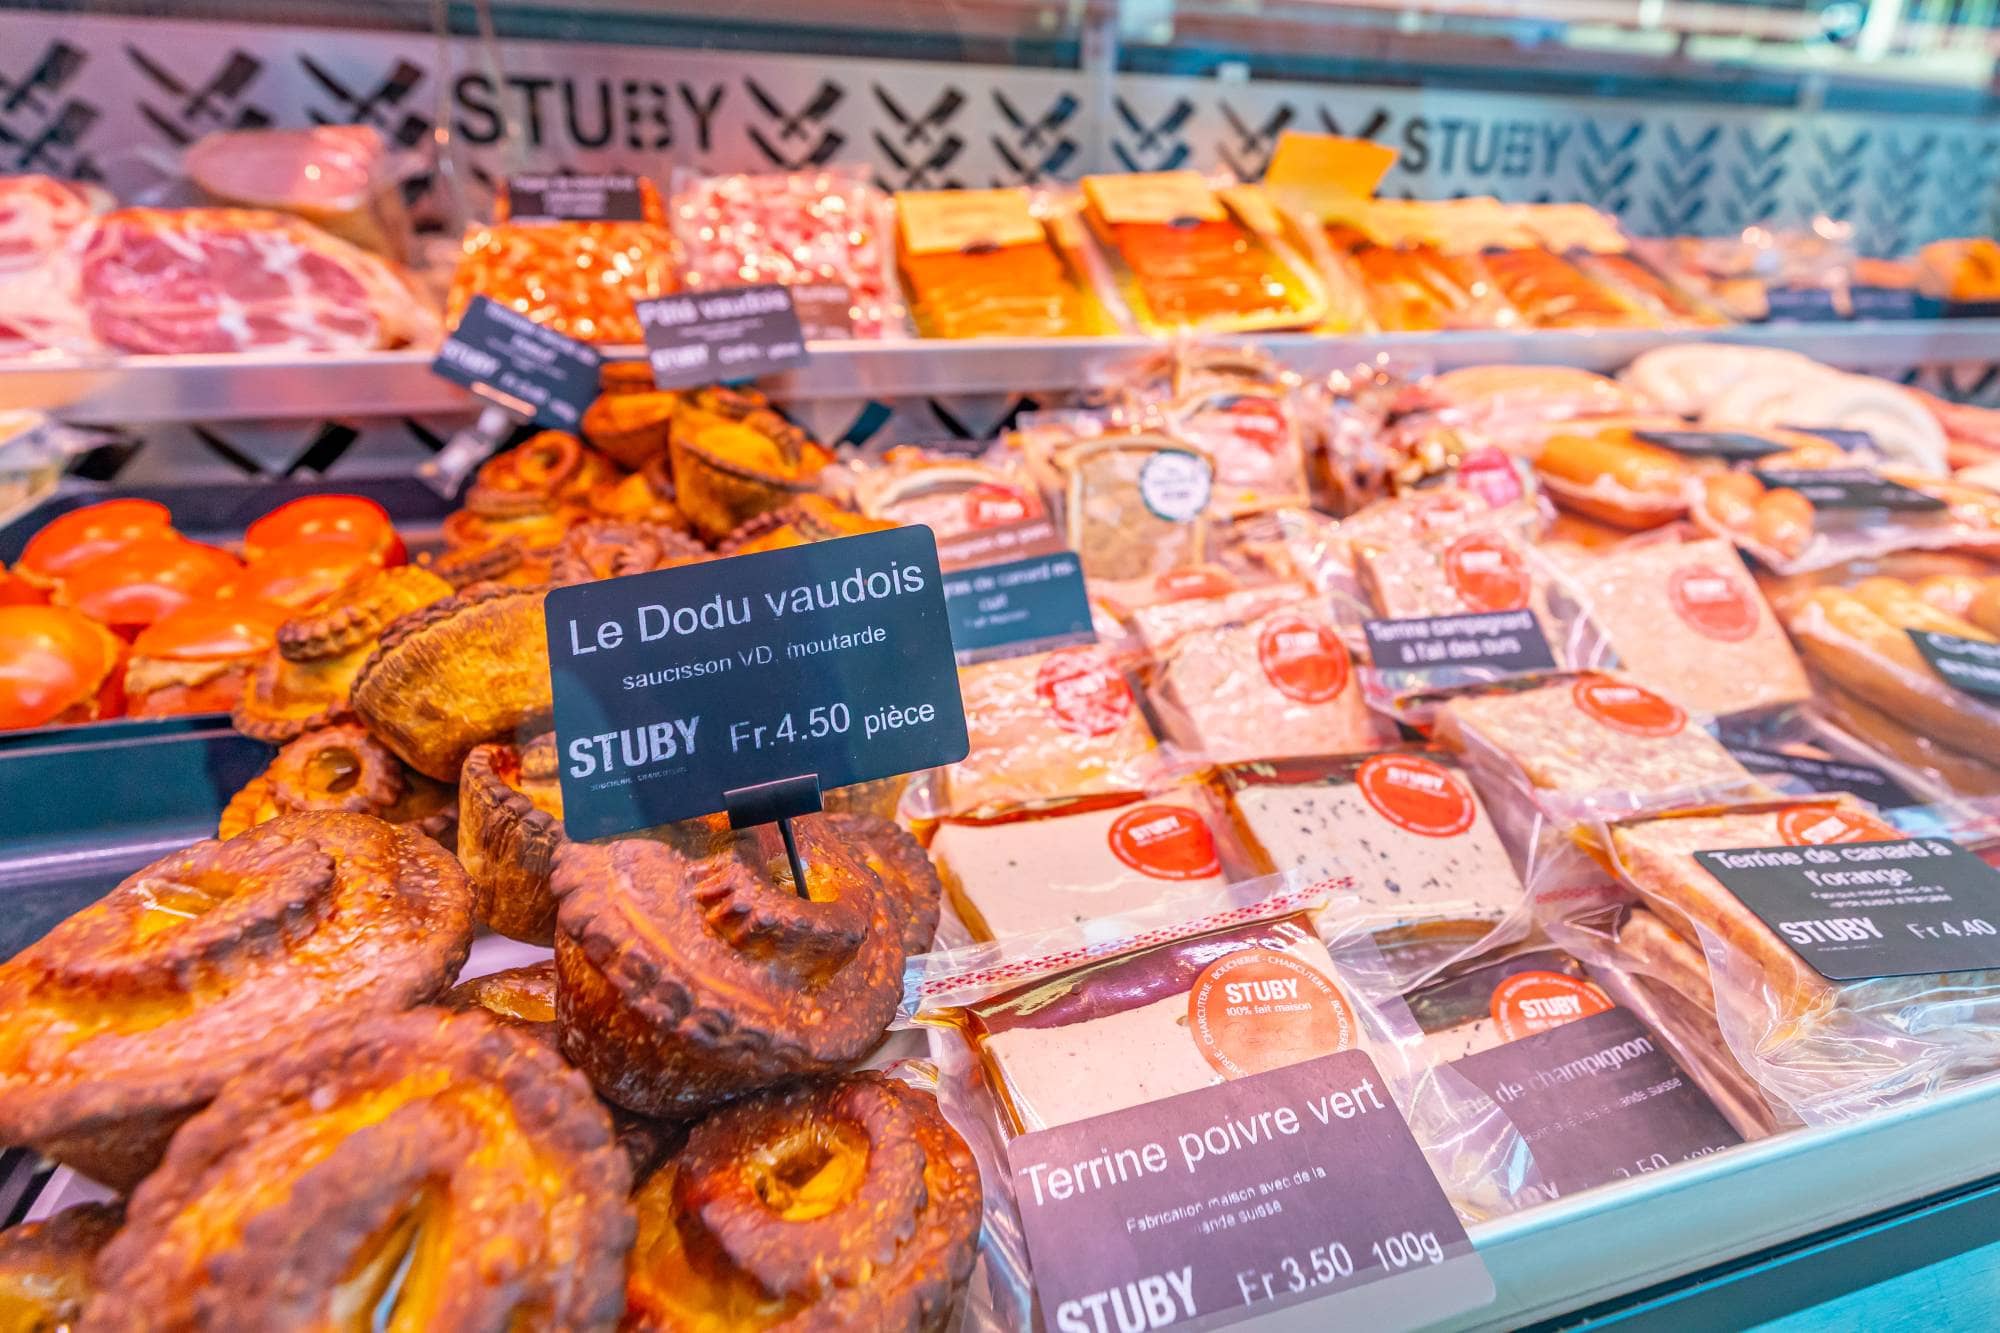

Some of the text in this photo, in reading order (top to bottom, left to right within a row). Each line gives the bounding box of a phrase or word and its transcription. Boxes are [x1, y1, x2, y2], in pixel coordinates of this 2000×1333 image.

[454, 74, 724, 151] STUBY
[1400, 116, 1573, 176] STUBY
[569, 561, 925, 656] Le Dodu vaudois
[622, 657, 732, 690] saucisson
[787, 625, 887, 659] moutarde
[568, 702, 935, 778] STUBY Fr.4.50 pièce
[1708, 839, 1953, 869] Terrine de canard à
[1803, 868, 1913, 887] l'orange
[1779, 916, 1884, 945] STUBY
[1940, 918, 1997, 938] 4.40
[1211, 954, 1262, 981] BOUCHERIE
[1268, 956, 1333, 995] CHARCUTERIE
[1224, 978, 1298, 1004] STUBY
[1197, 982, 1215, 1046] CHARCUTERIE
[1226, 1001, 1313, 1018] 100% fait maison
[1518, 994, 1581, 1018] STUBY
[1496, 1036, 1656, 1103] de champignon
[1646, 1076, 1684, 1098] suisse
[1019, 1139, 1168, 1206] Terrine
[1180, 1106, 1300, 1173] poivre
[1306, 1077, 1386, 1126] vert
[1126, 1166, 1327, 1235] Fabrication maison avec de la
[1196, 1199, 1283, 1235] ande suisse
[1056, 1265, 1199, 1333] STUBY
[1280, 1240, 1355, 1294] 3.50
[1371, 1229, 1445, 1272] 100g
